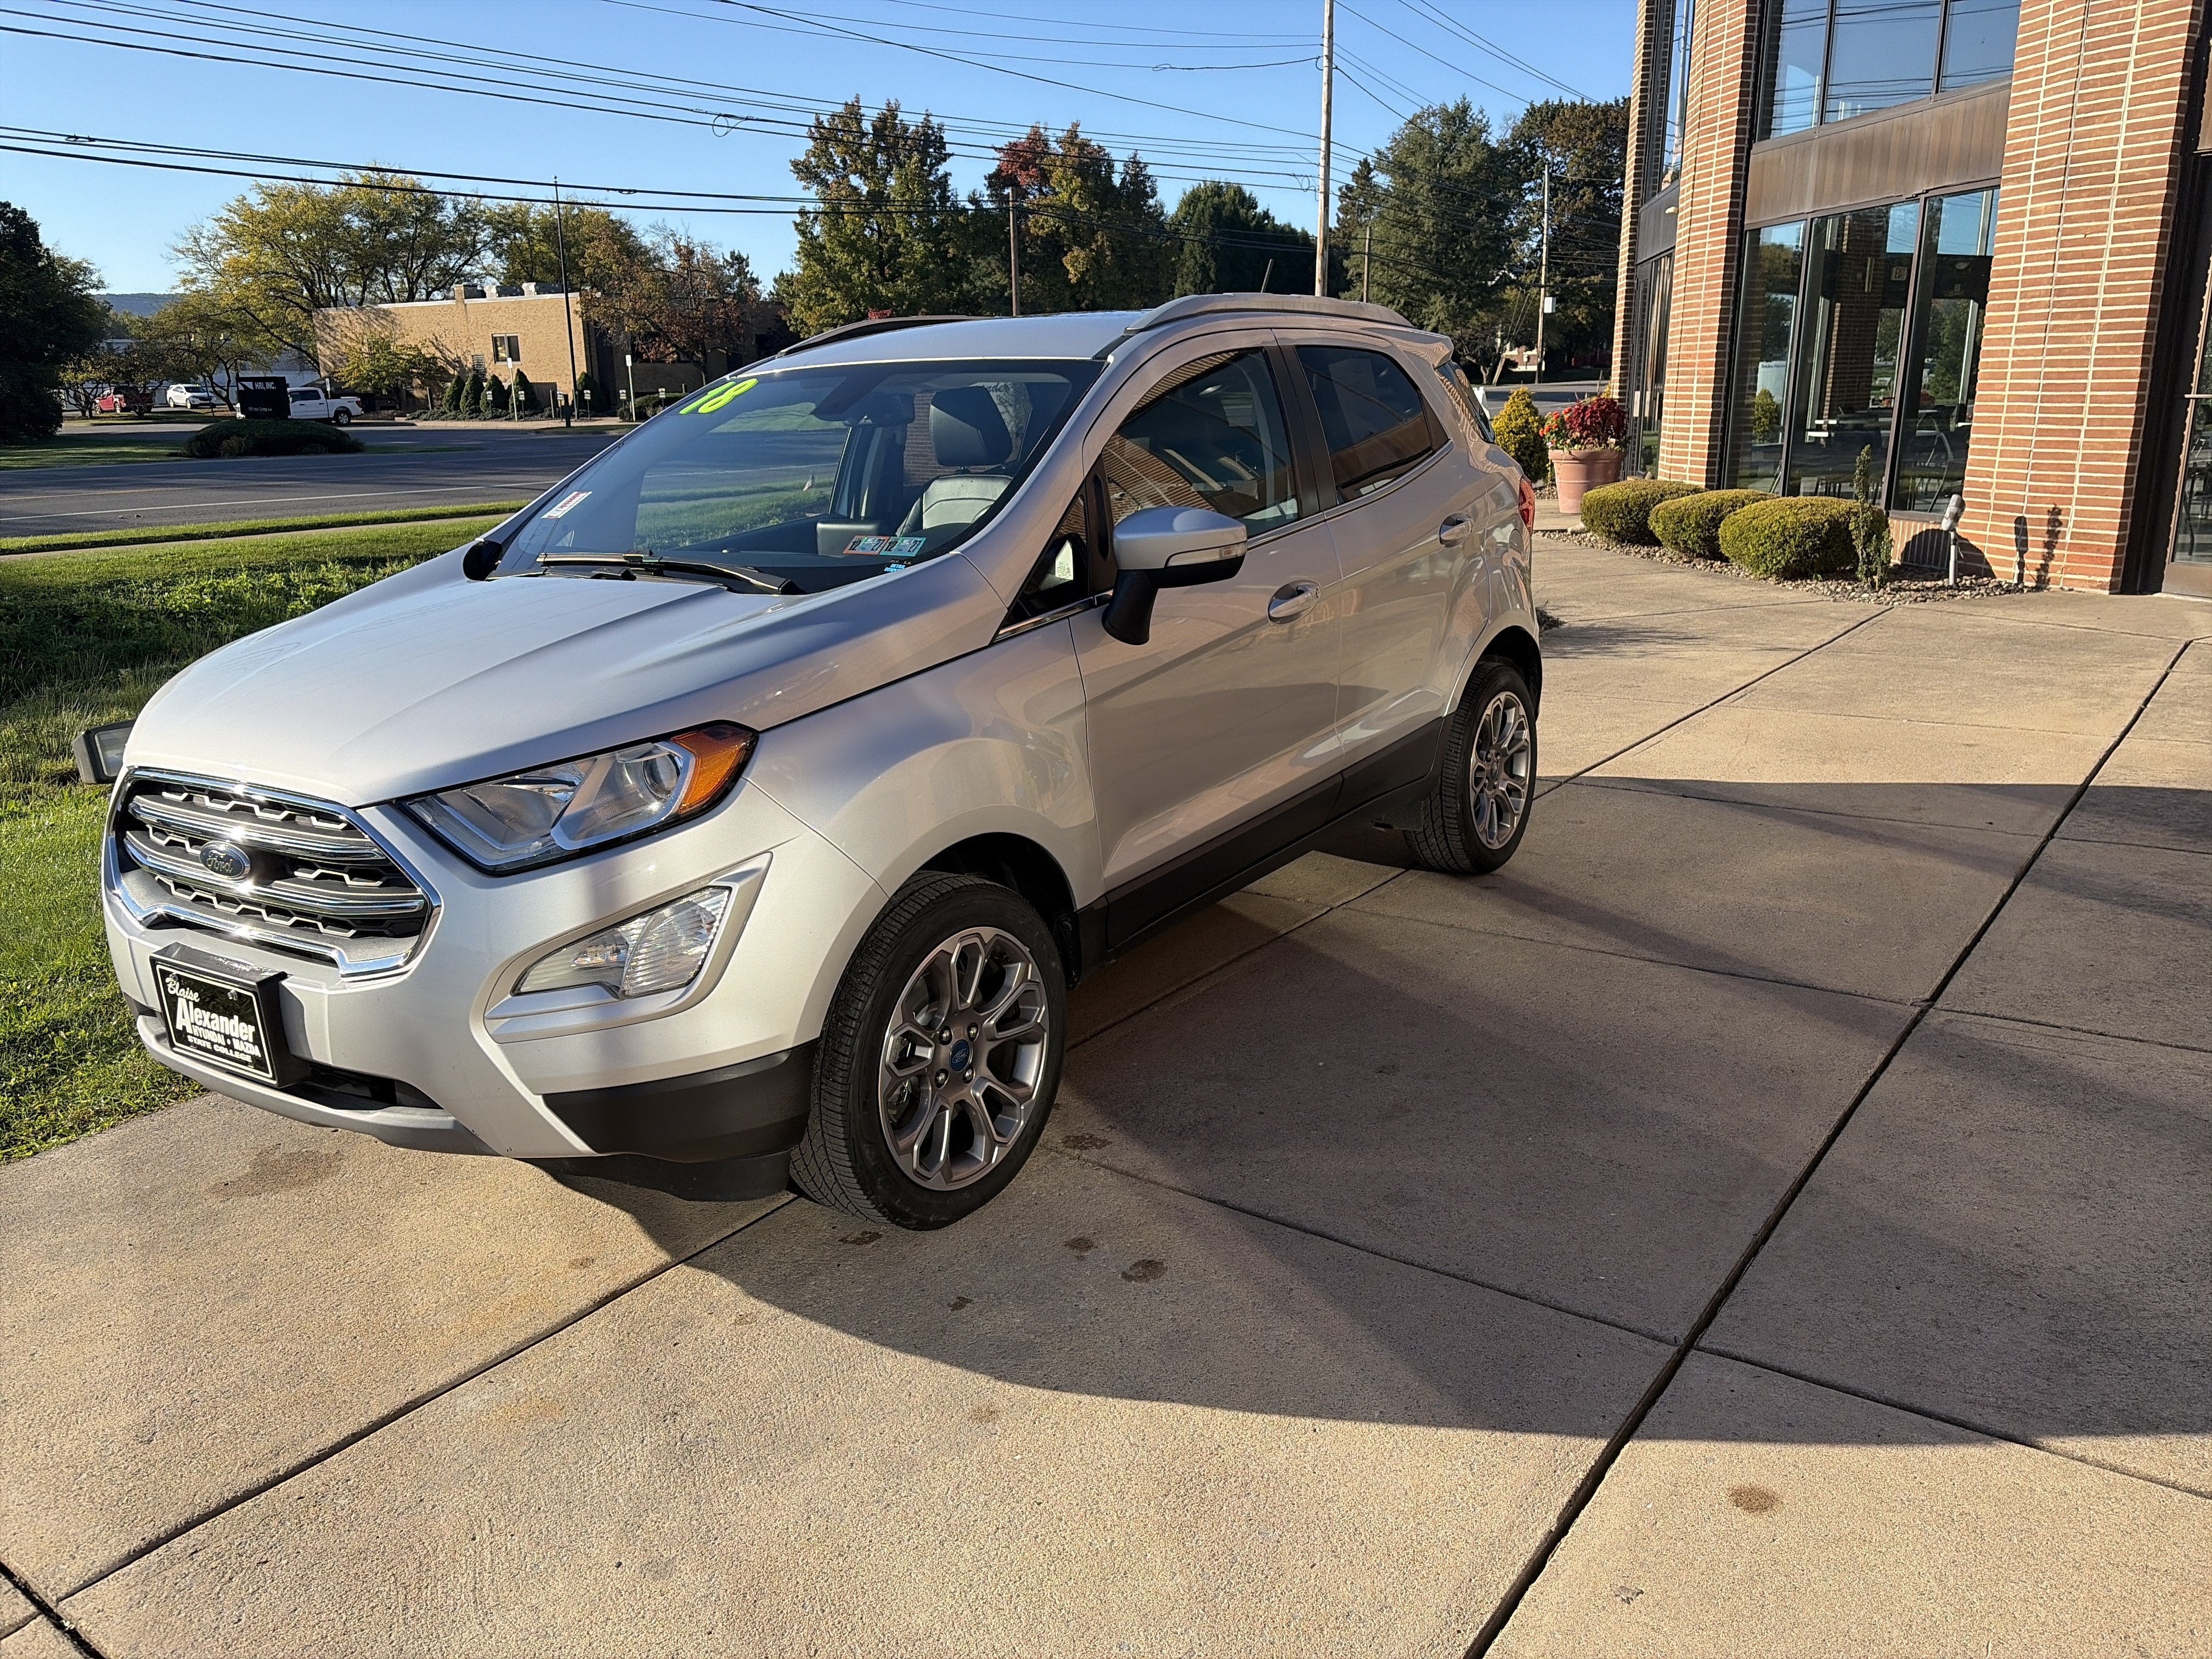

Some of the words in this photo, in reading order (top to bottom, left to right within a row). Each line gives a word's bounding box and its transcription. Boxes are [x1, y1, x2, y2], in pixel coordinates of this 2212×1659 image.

[679, 378, 759, 414] 18
[849, 540, 862, 551] 12
[871, 539, 886, 551] 27
[884, 540, 898, 552] 12
[907, 540, 922, 552] 27
[207, 850, 234, 873] Ford
[166, 973, 200, 1002] Blaise
[176, 997, 255, 1042] Alexander
[187, 1035, 212, 1049] STATE
[213, 1044, 252, 1063] COLLEGE
[192, 1025, 226, 1046] HYUNDAI
[232, 1038, 261, 1057] MAZDA
